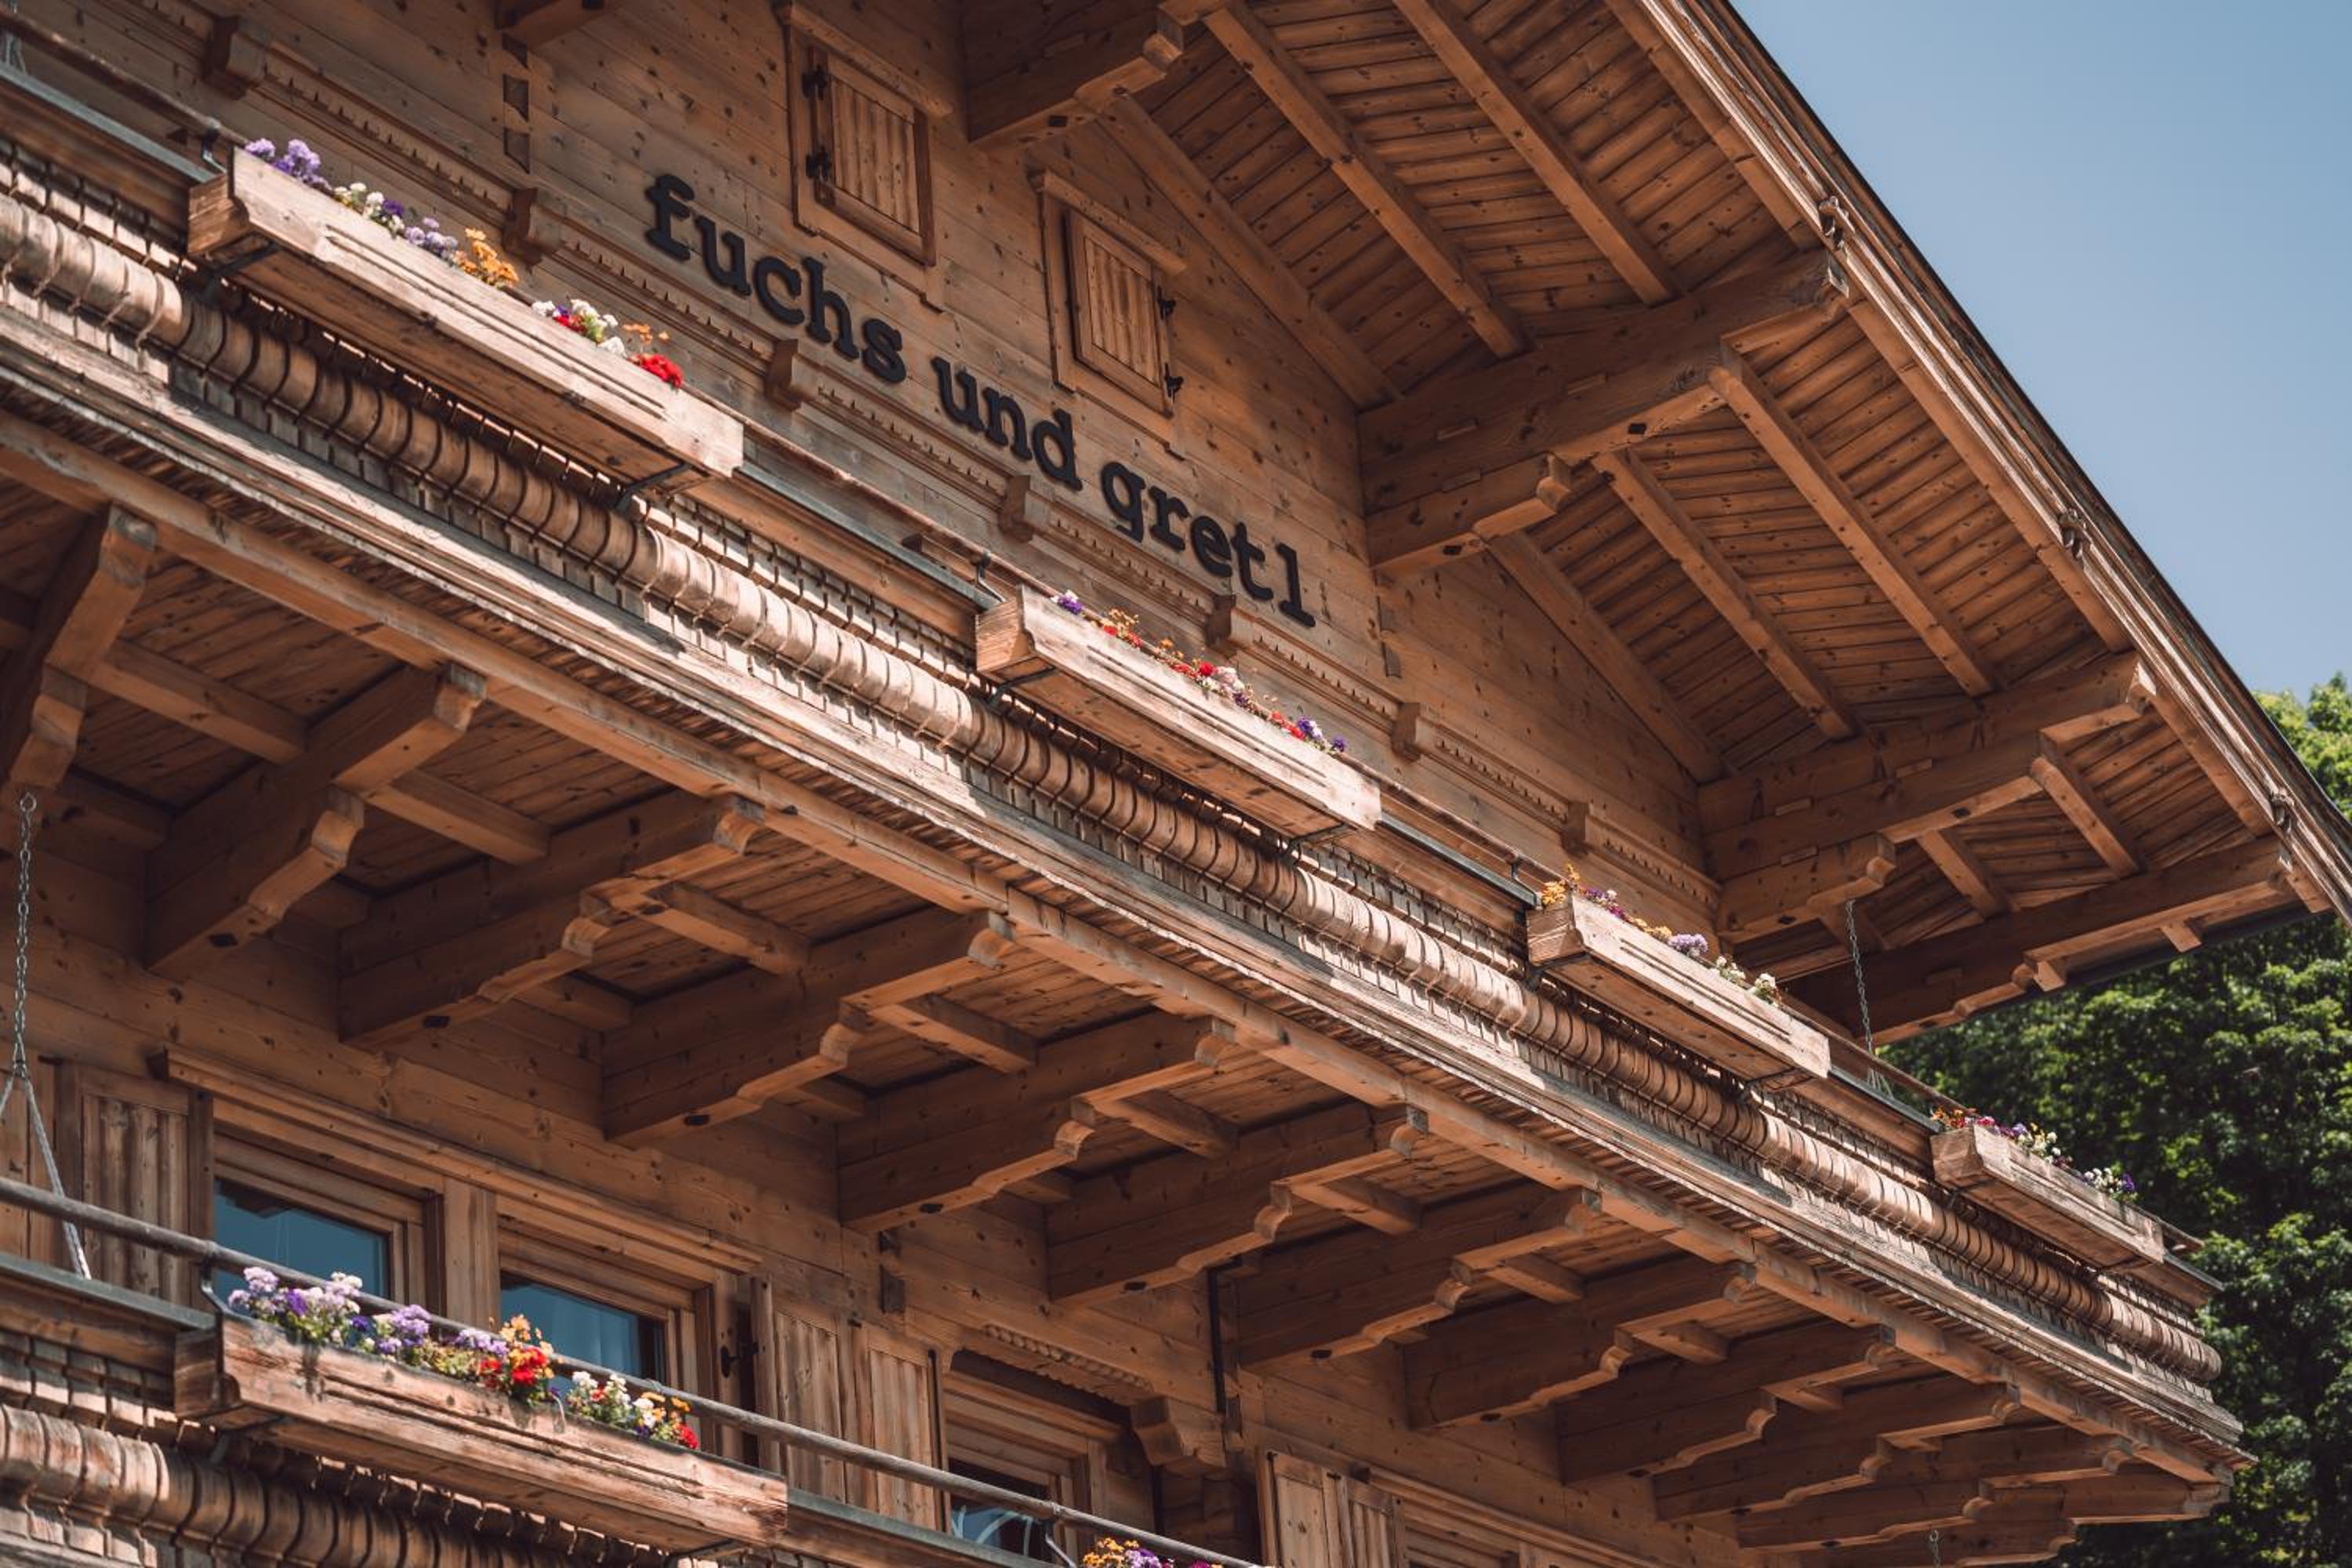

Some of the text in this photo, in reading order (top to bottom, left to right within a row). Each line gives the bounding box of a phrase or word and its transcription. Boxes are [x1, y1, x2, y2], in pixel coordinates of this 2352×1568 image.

[645, 174, 1316, 628] fuchs und gretl
